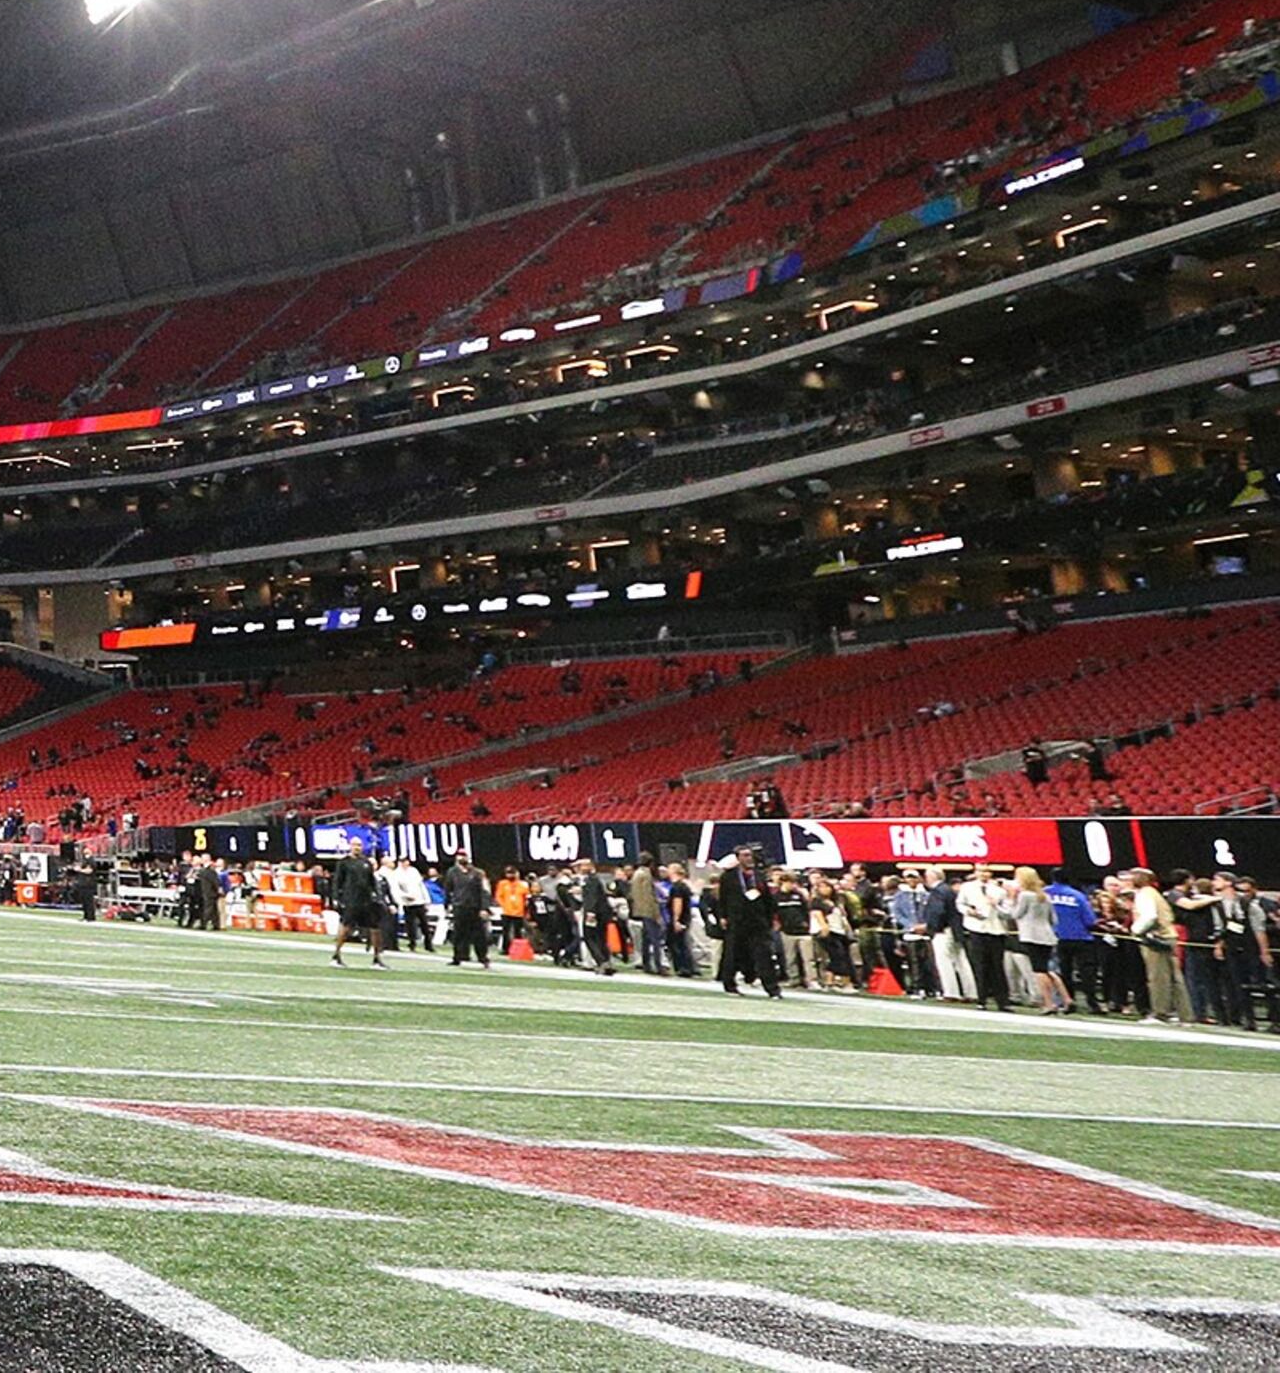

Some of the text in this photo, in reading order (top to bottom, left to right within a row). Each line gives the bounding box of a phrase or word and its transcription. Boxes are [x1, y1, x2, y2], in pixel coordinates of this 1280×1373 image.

[529, 825, 579, 860] 66:39
[890, 825, 988, 857] FALCONS
[1084, 822, 1111, 866] 0
